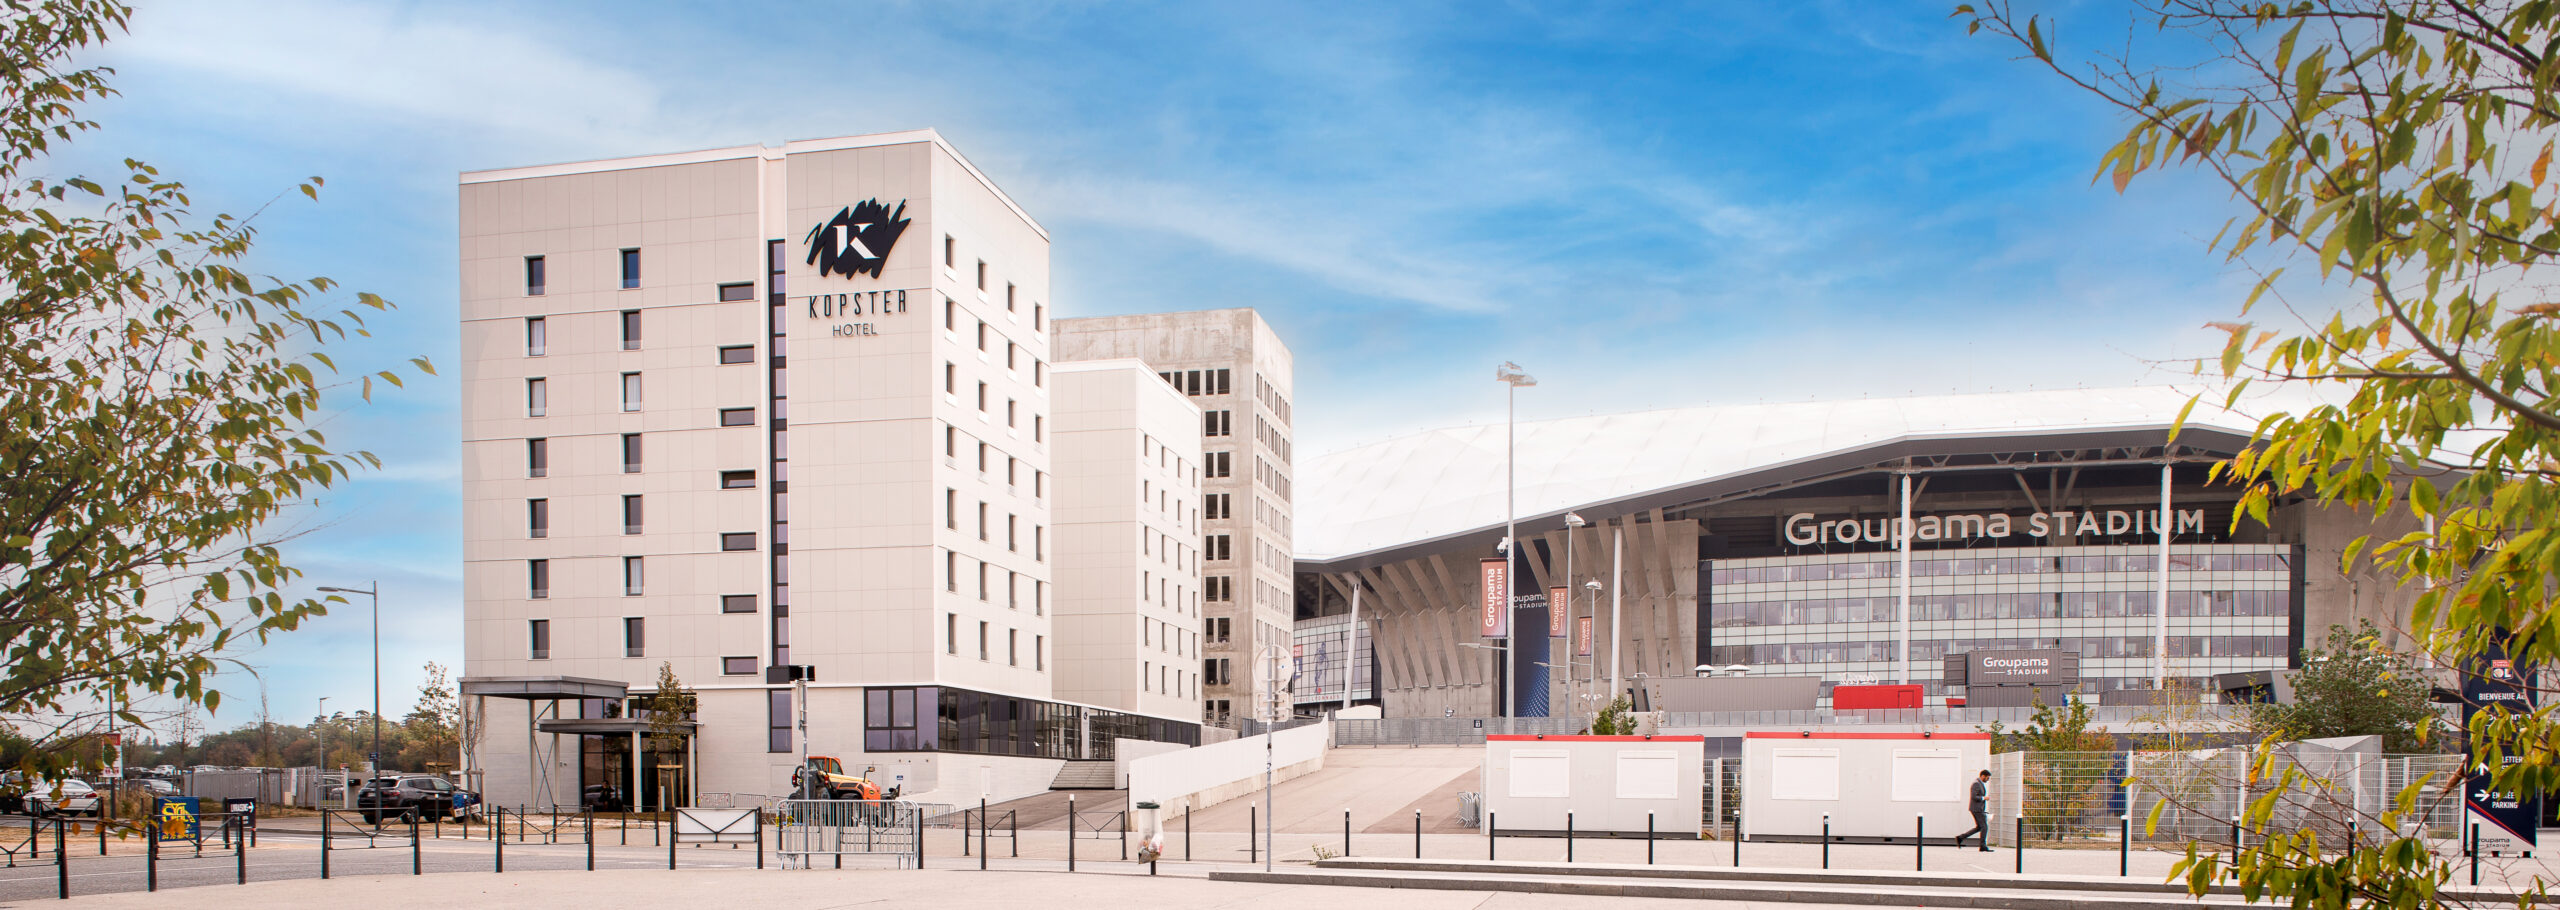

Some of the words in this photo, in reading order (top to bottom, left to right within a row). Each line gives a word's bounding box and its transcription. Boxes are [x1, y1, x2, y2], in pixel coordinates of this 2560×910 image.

[809, 289, 906, 319] KOPSTER
[832, 322, 878, 337] HOTEL
[1784, 512, 2012, 550] Groupama
[2028, 508, 2204, 538] STADIUM
[1485, 568, 1497, 628] Groupama
[1551, 592, 1560, 631] Groupama
[1983, 656, 2049, 669] Groupama
[2006, 668, 2049, 676] STADIUM
[2478, 692, 2516, 701] BIENVENUE
[2492, 790, 2515, 799] ENÉE
